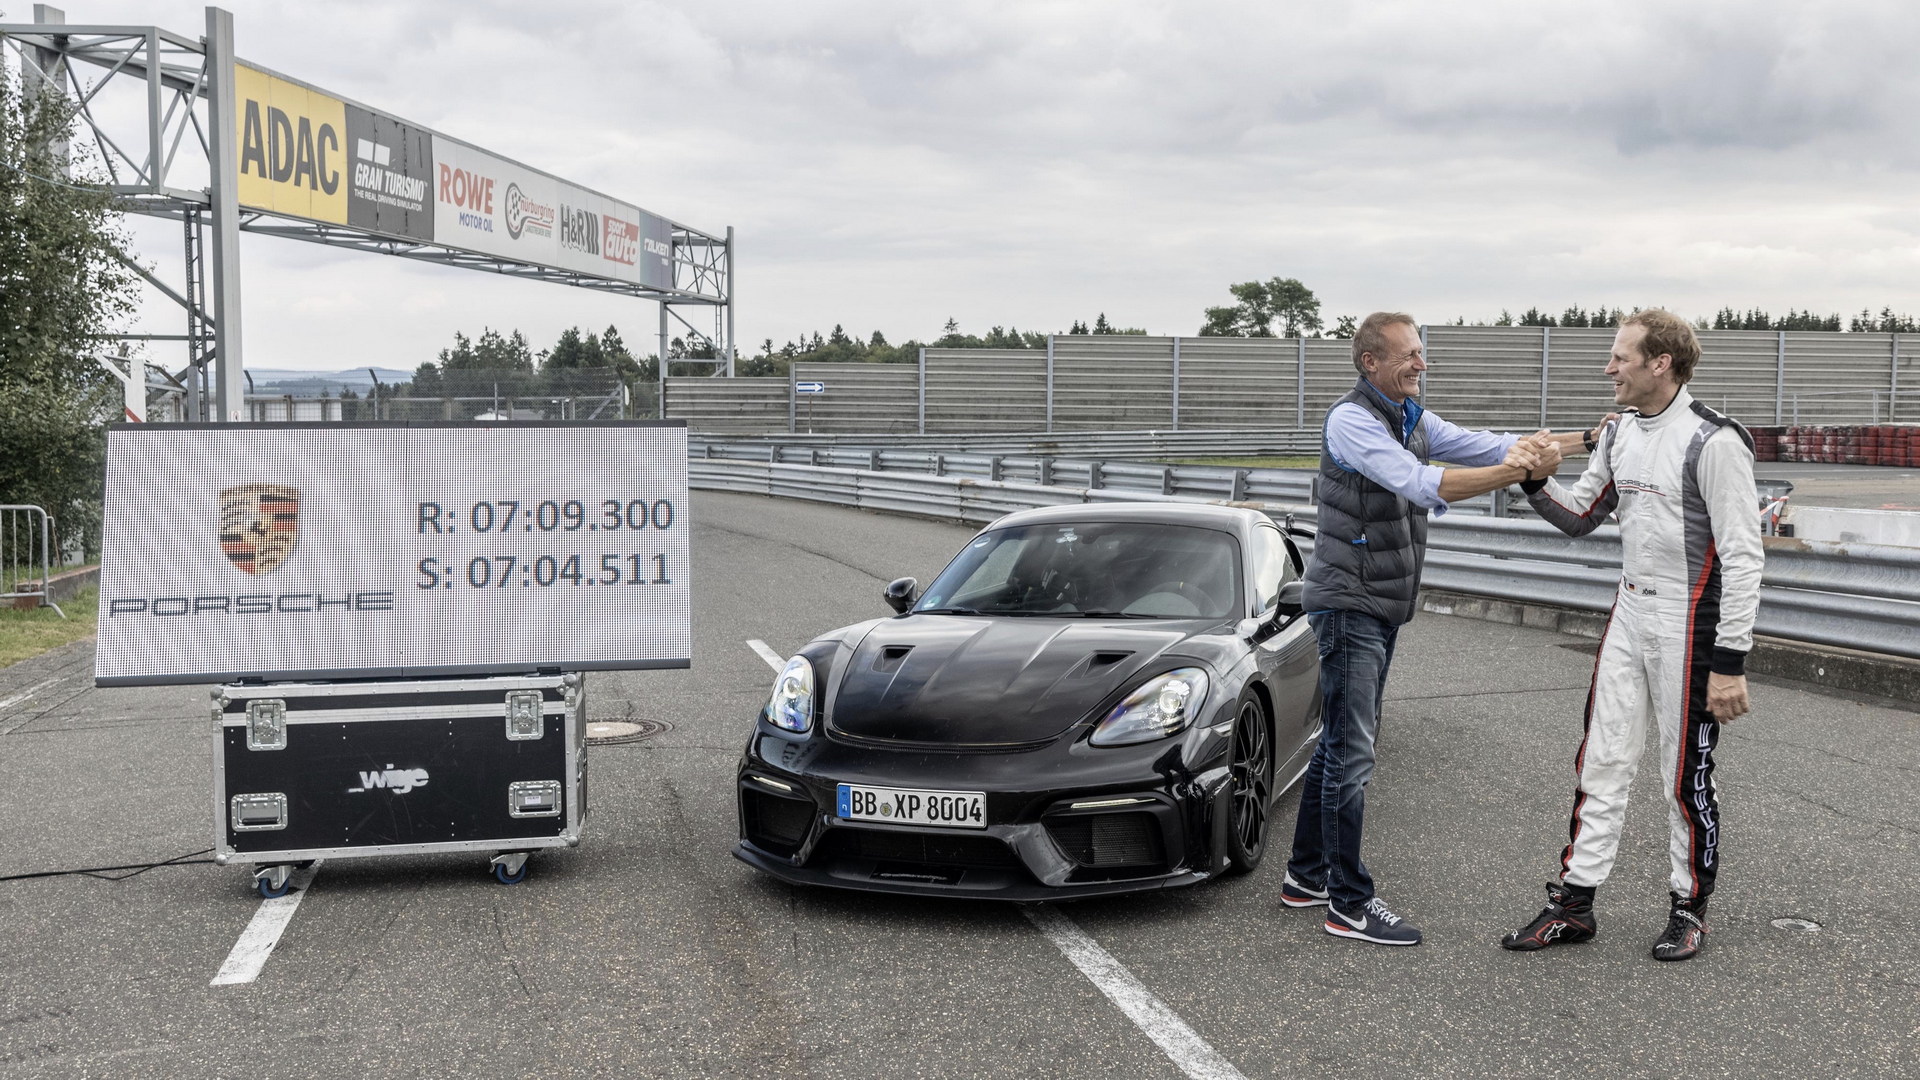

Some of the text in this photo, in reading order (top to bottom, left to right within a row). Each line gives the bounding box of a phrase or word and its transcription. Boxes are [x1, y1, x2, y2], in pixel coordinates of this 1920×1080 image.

[240, 98, 340, 196] ADAC
[354, 162, 382, 192] GRAN
[438, 162, 494, 215] ROWE
[354, 188, 365, 199] THE
[459, 212, 494, 233] MOTOR OIL
[560, 203, 587, 253] H&R
[607, 219, 626, 237] sport
[605, 232, 639, 263] auto
[417, 499, 675, 534] R: 07:09.300
[416, 553, 672, 590] S: 07:04.511
[109, 591, 395, 619] PORSCHE
[852, 790, 982, 822] BB XP 8004
[1693, 722, 1717, 868] PORSCHE
